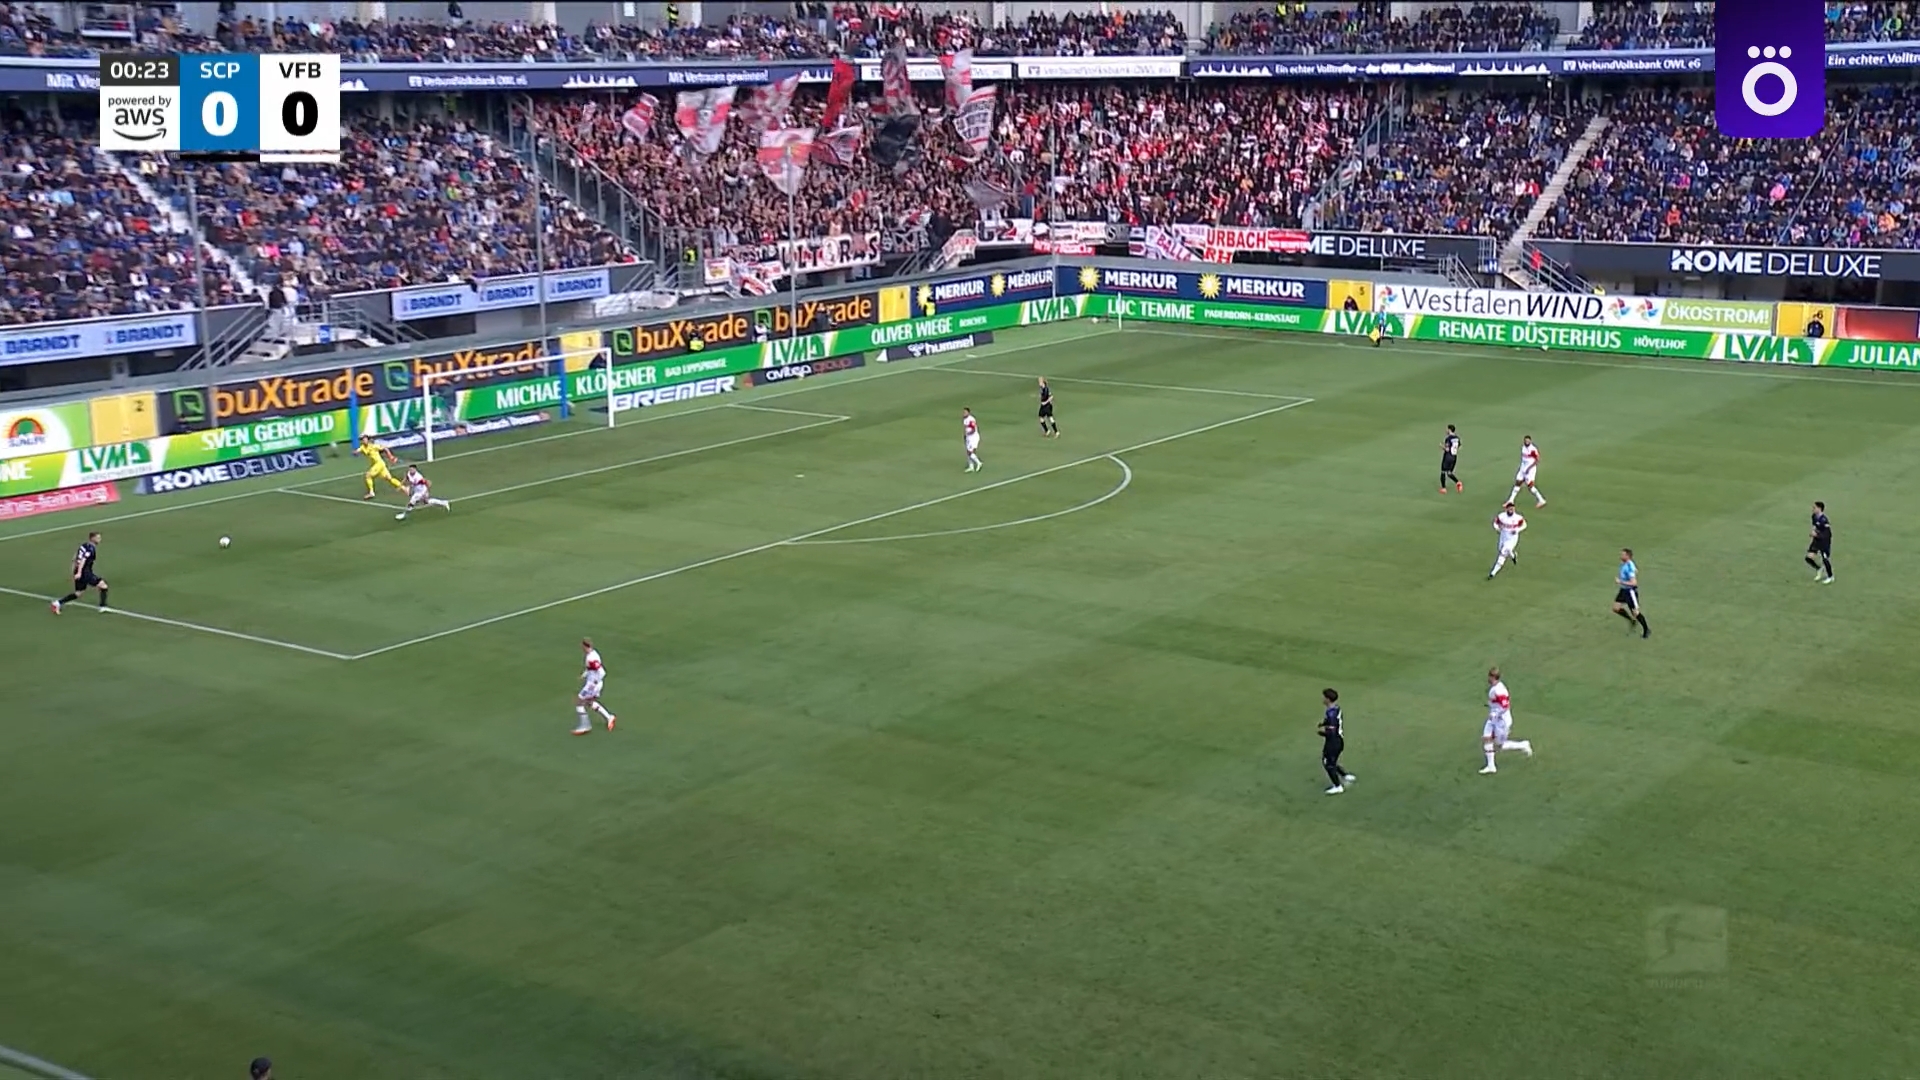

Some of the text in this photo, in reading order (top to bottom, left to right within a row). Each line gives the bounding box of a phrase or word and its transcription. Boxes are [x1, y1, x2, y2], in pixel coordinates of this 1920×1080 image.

[1828, 54, 1846, 66] Ein
[1847, 53, 1885, 66] echter
[1206, 228, 1267, 250] URBACH
[1339, 236, 1426, 259] DELUXE
[1670, 250, 1881, 278] HOME DELUXE
[556, 276, 603, 294] BRANDT
[934, 280, 985, 300] MERKUR
[1007, 270, 1053, 289] MERKUR
[1104, 270, 1178, 290] MERKUR
[1226, 277, 1305, 298] MERKUR
[409, 293, 463, 311] BRANDT
[486, 284, 535, 302] BRANDT
[1107, 299, 1196, 320] LUC TEMME
[1667, 301, 1770, 325] ÖKOSTROM!
[115, 323, 186, 344] BRANDT
[871, 322, 914, 346] OLIVER
[915, 316, 954, 338] WIEGE
[1438, 320, 1688, 350] RENATE DÜSTERHUS HÖVELHOF
[5, 334, 82, 354] BRANDT
[924, 333, 975, 355] hummel
[213, 367, 374, 418] buXtrade
[496, 379, 573, 409] MICHAE
[612, 375, 736, 411] BREMER
[201, 414, 335, 451] SVEN GERHOLD
[152, 464, 231, 493] HOME
[230, 449, 318, 480] DELUXE
